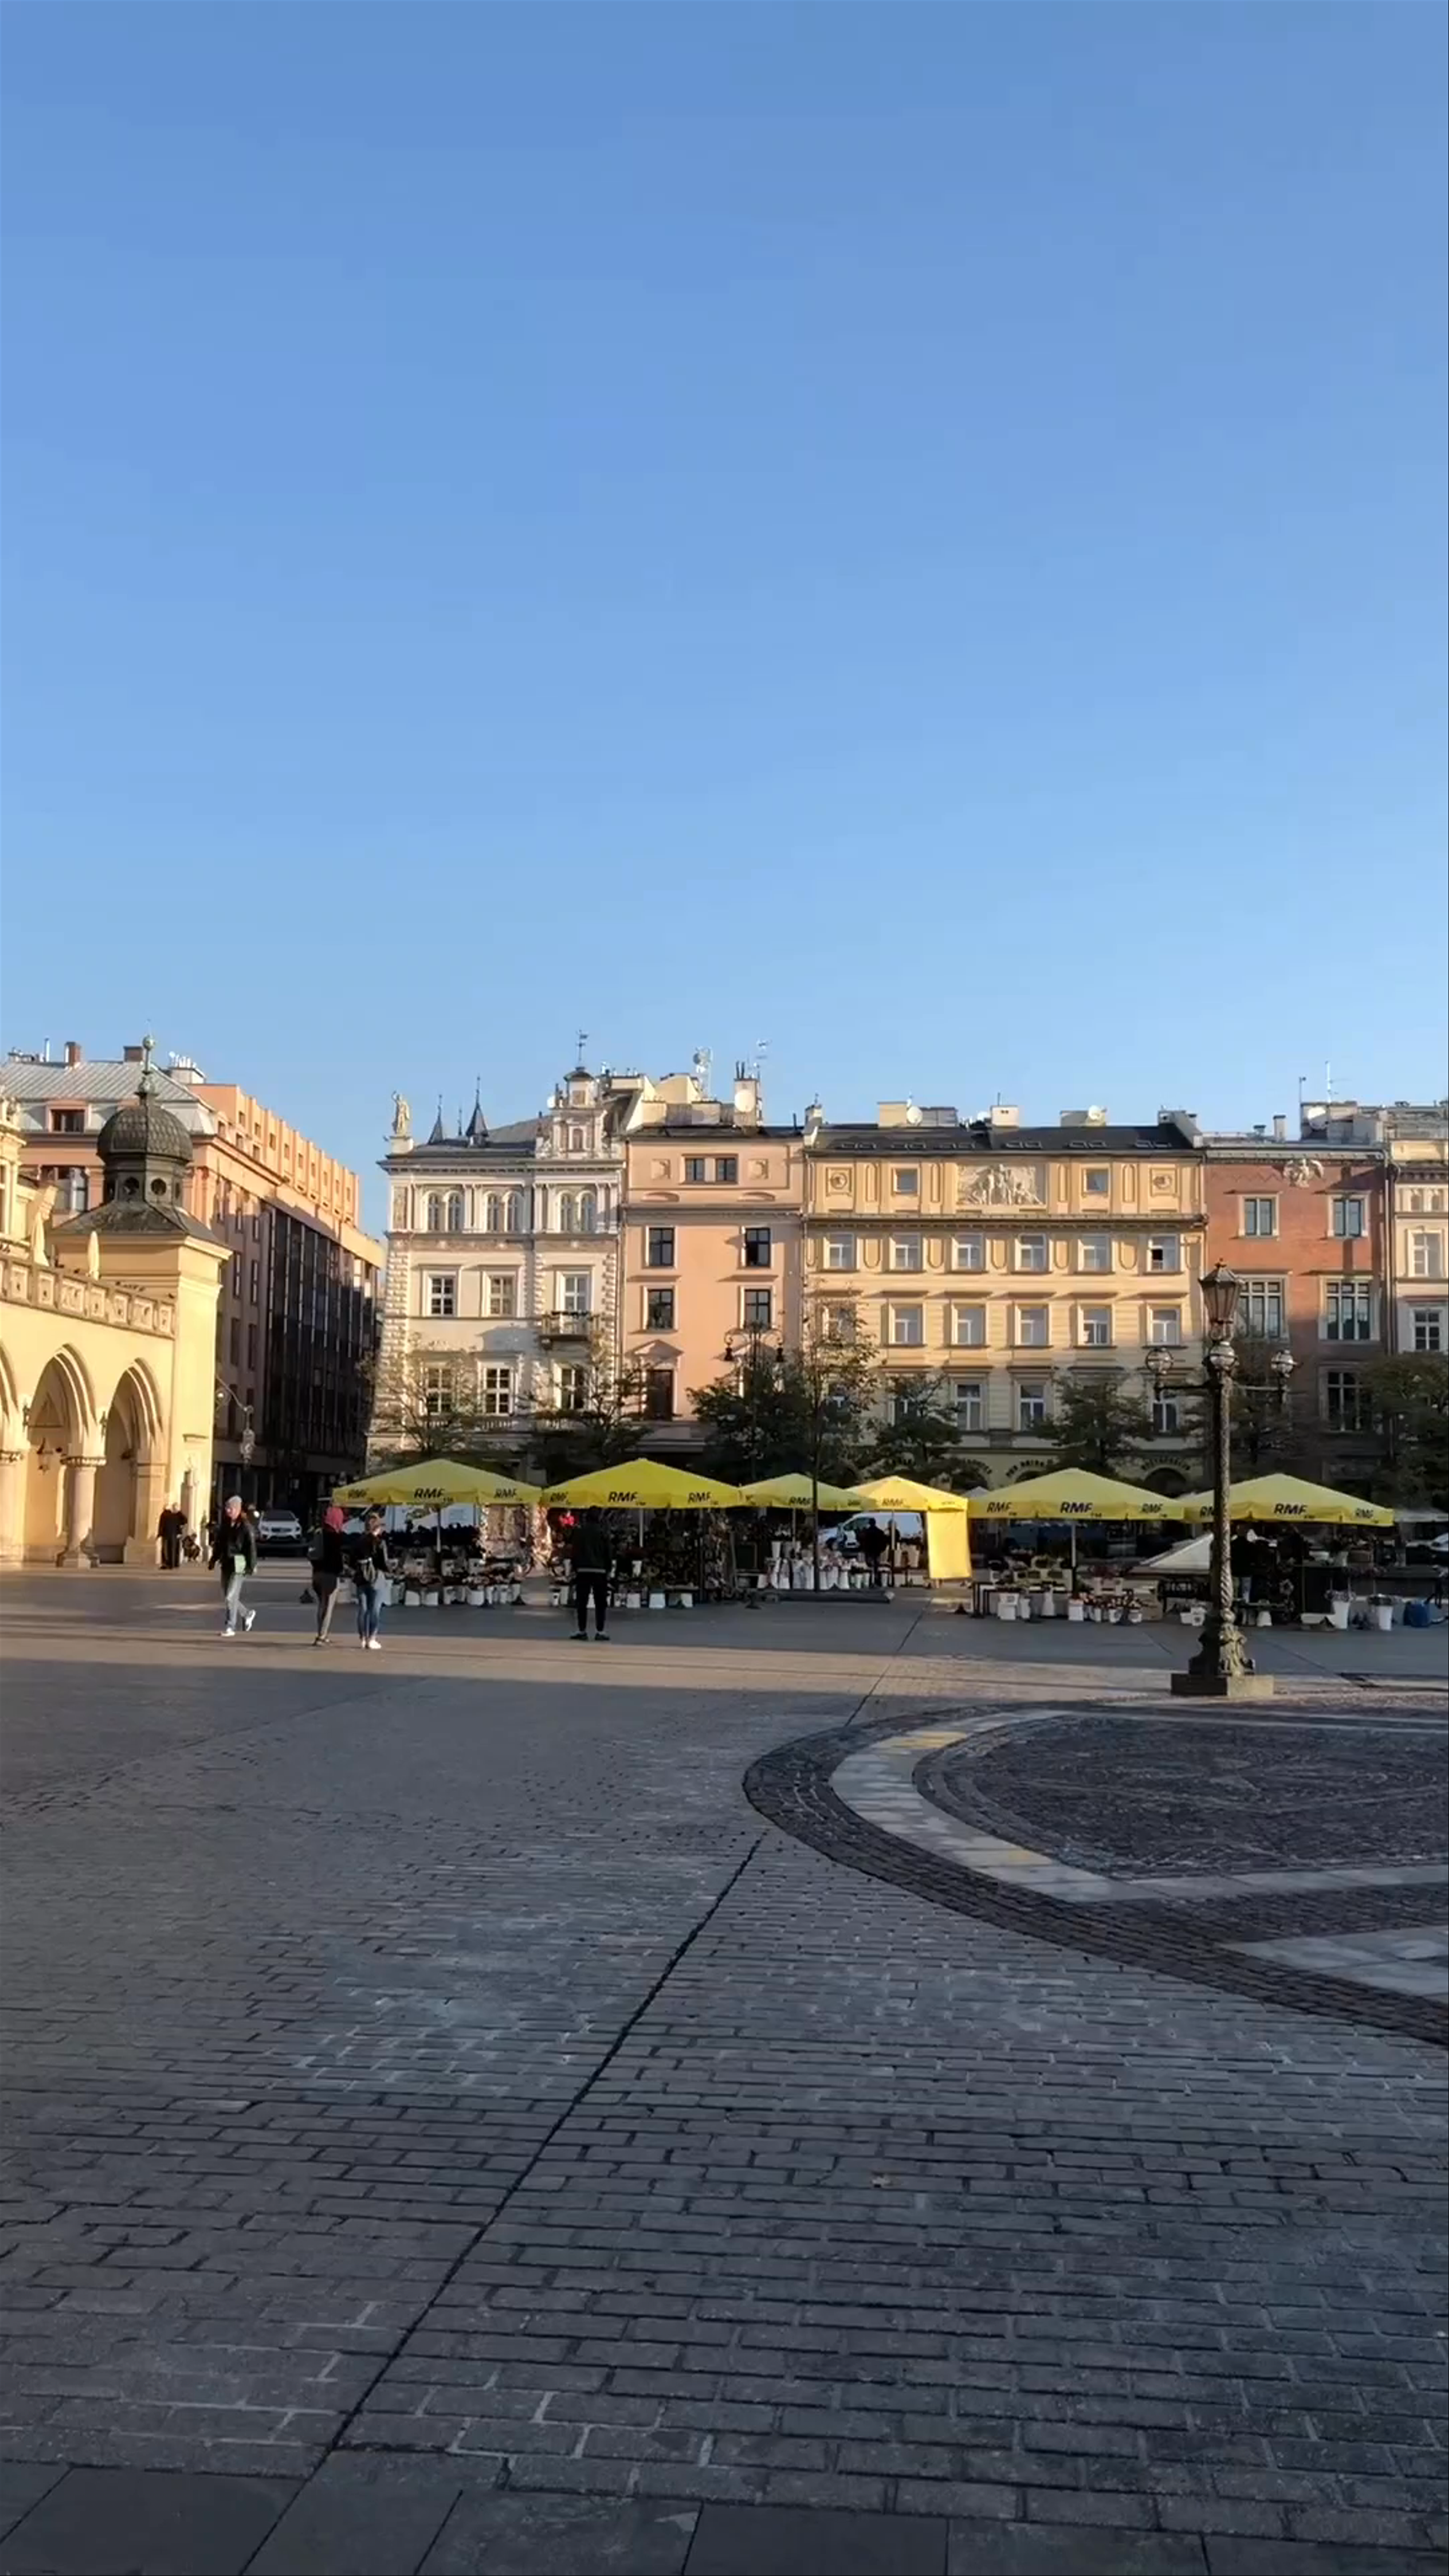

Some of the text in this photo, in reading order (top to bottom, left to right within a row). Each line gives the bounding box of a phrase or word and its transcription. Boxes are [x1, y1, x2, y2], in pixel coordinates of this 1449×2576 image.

[414, 1488, 444, 1498] RMF
[494, 1489, 517, 1498] RMF
[608, 1492, 638, 1502] RMF
[688, 1492, 711, 1503] RMF
[987, 1501, 1012, 1513] RMF
[1060, 1501, 1093, 1513] RMF
[1274, 1503, 1307, 1515] RMF
